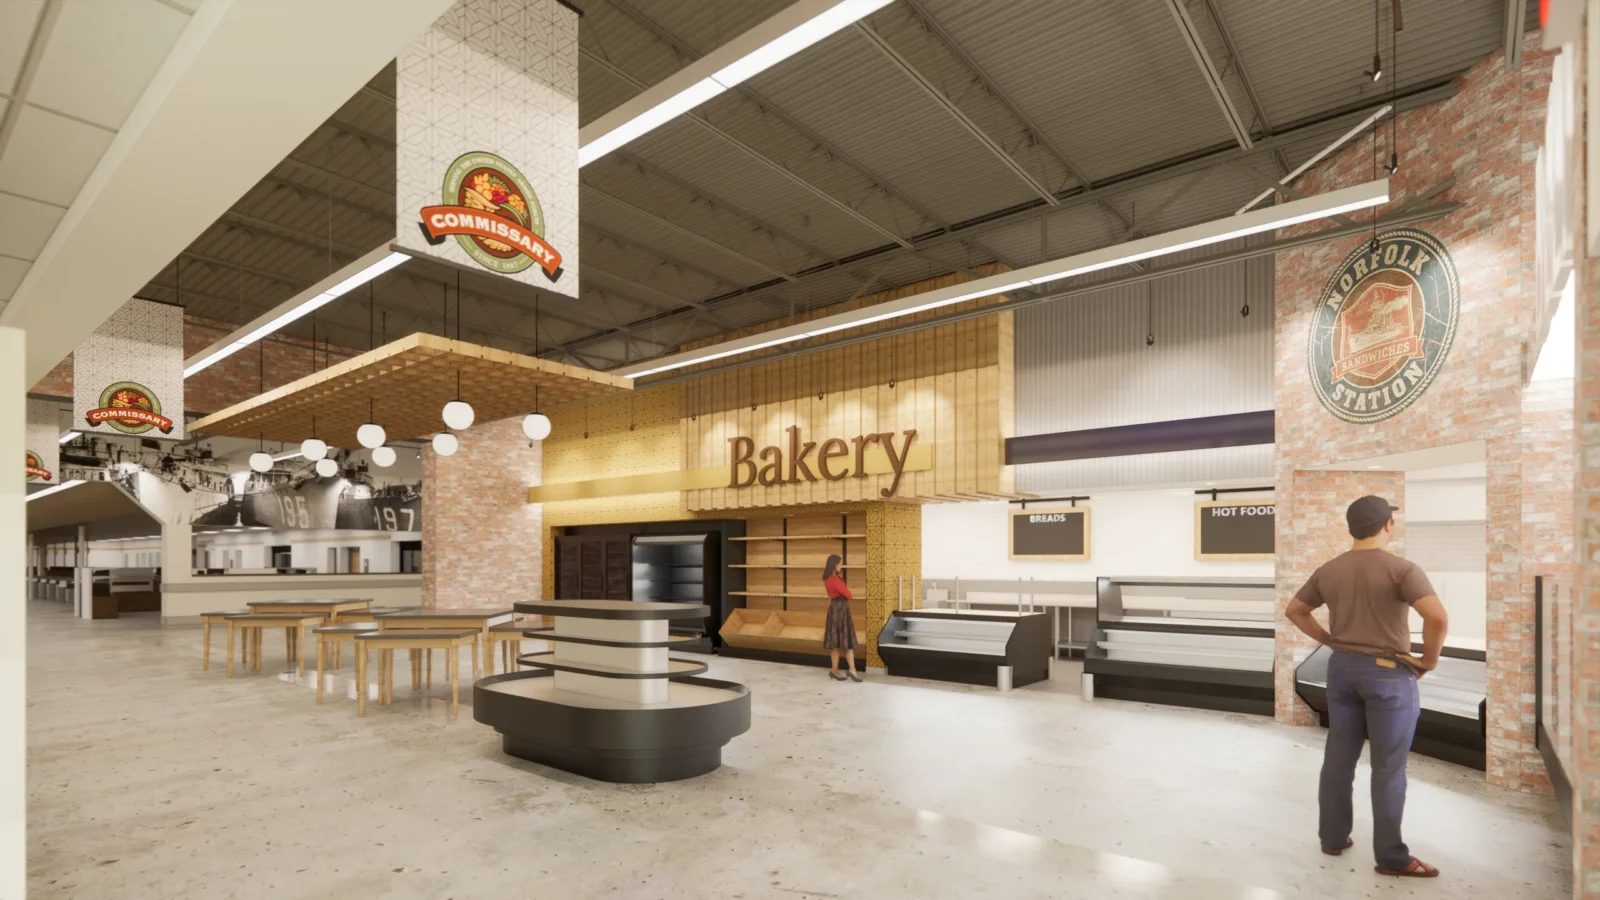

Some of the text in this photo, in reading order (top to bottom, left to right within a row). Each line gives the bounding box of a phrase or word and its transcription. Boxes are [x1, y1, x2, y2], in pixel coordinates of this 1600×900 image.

[431, 214, 555, 264] COMMISSARY
[1326, 244, 1431, 312] NORFOLK
[1341, 341, 1410, 372] SANDWICHES
[1331, 360, 1425, 411] STATION
[92, 410, 168, 426] COMMISSARY
[727, 424, 917, 498] Bakery
[374, 506, 415, 532] 197
[1029, 513, 1066, 524] BREADS
[1212, 506, 1276, 517] HOT FOOD
